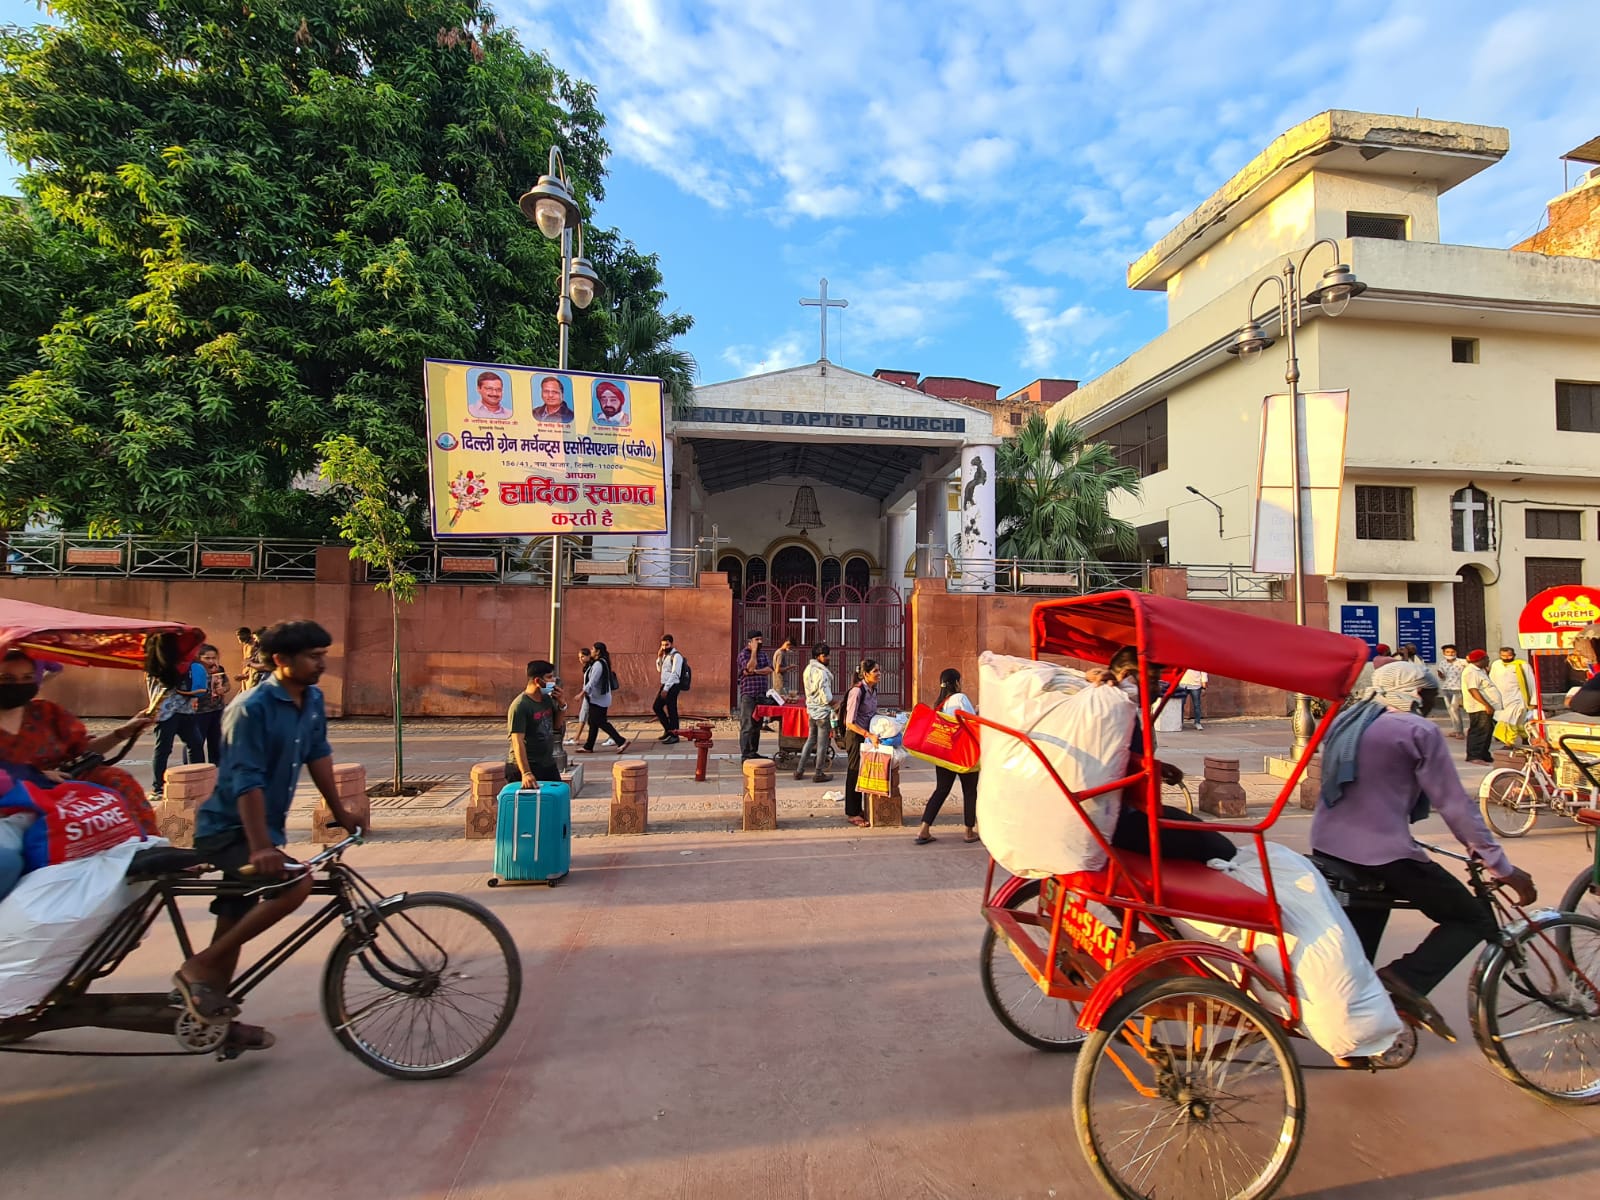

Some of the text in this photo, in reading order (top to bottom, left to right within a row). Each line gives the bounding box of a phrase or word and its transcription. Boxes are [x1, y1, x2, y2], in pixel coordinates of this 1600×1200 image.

[690, 408, 954, 431] ENTRAL BAPTIST CHURCH
[461, 433, 495, 452] दिल्ली
[497, 436, 517, 454] ग्रेन
[562, 437, 619, 457] एसोसिएशन
[565, 472, 596, 480] आपका
[499, 475, 656, 506] हार्दिक स्वागत
[552, 509, 614, 528] करती है
[1548, 610, 1595, 618] SUPREME
[65, 806, 130, 841] STORE
